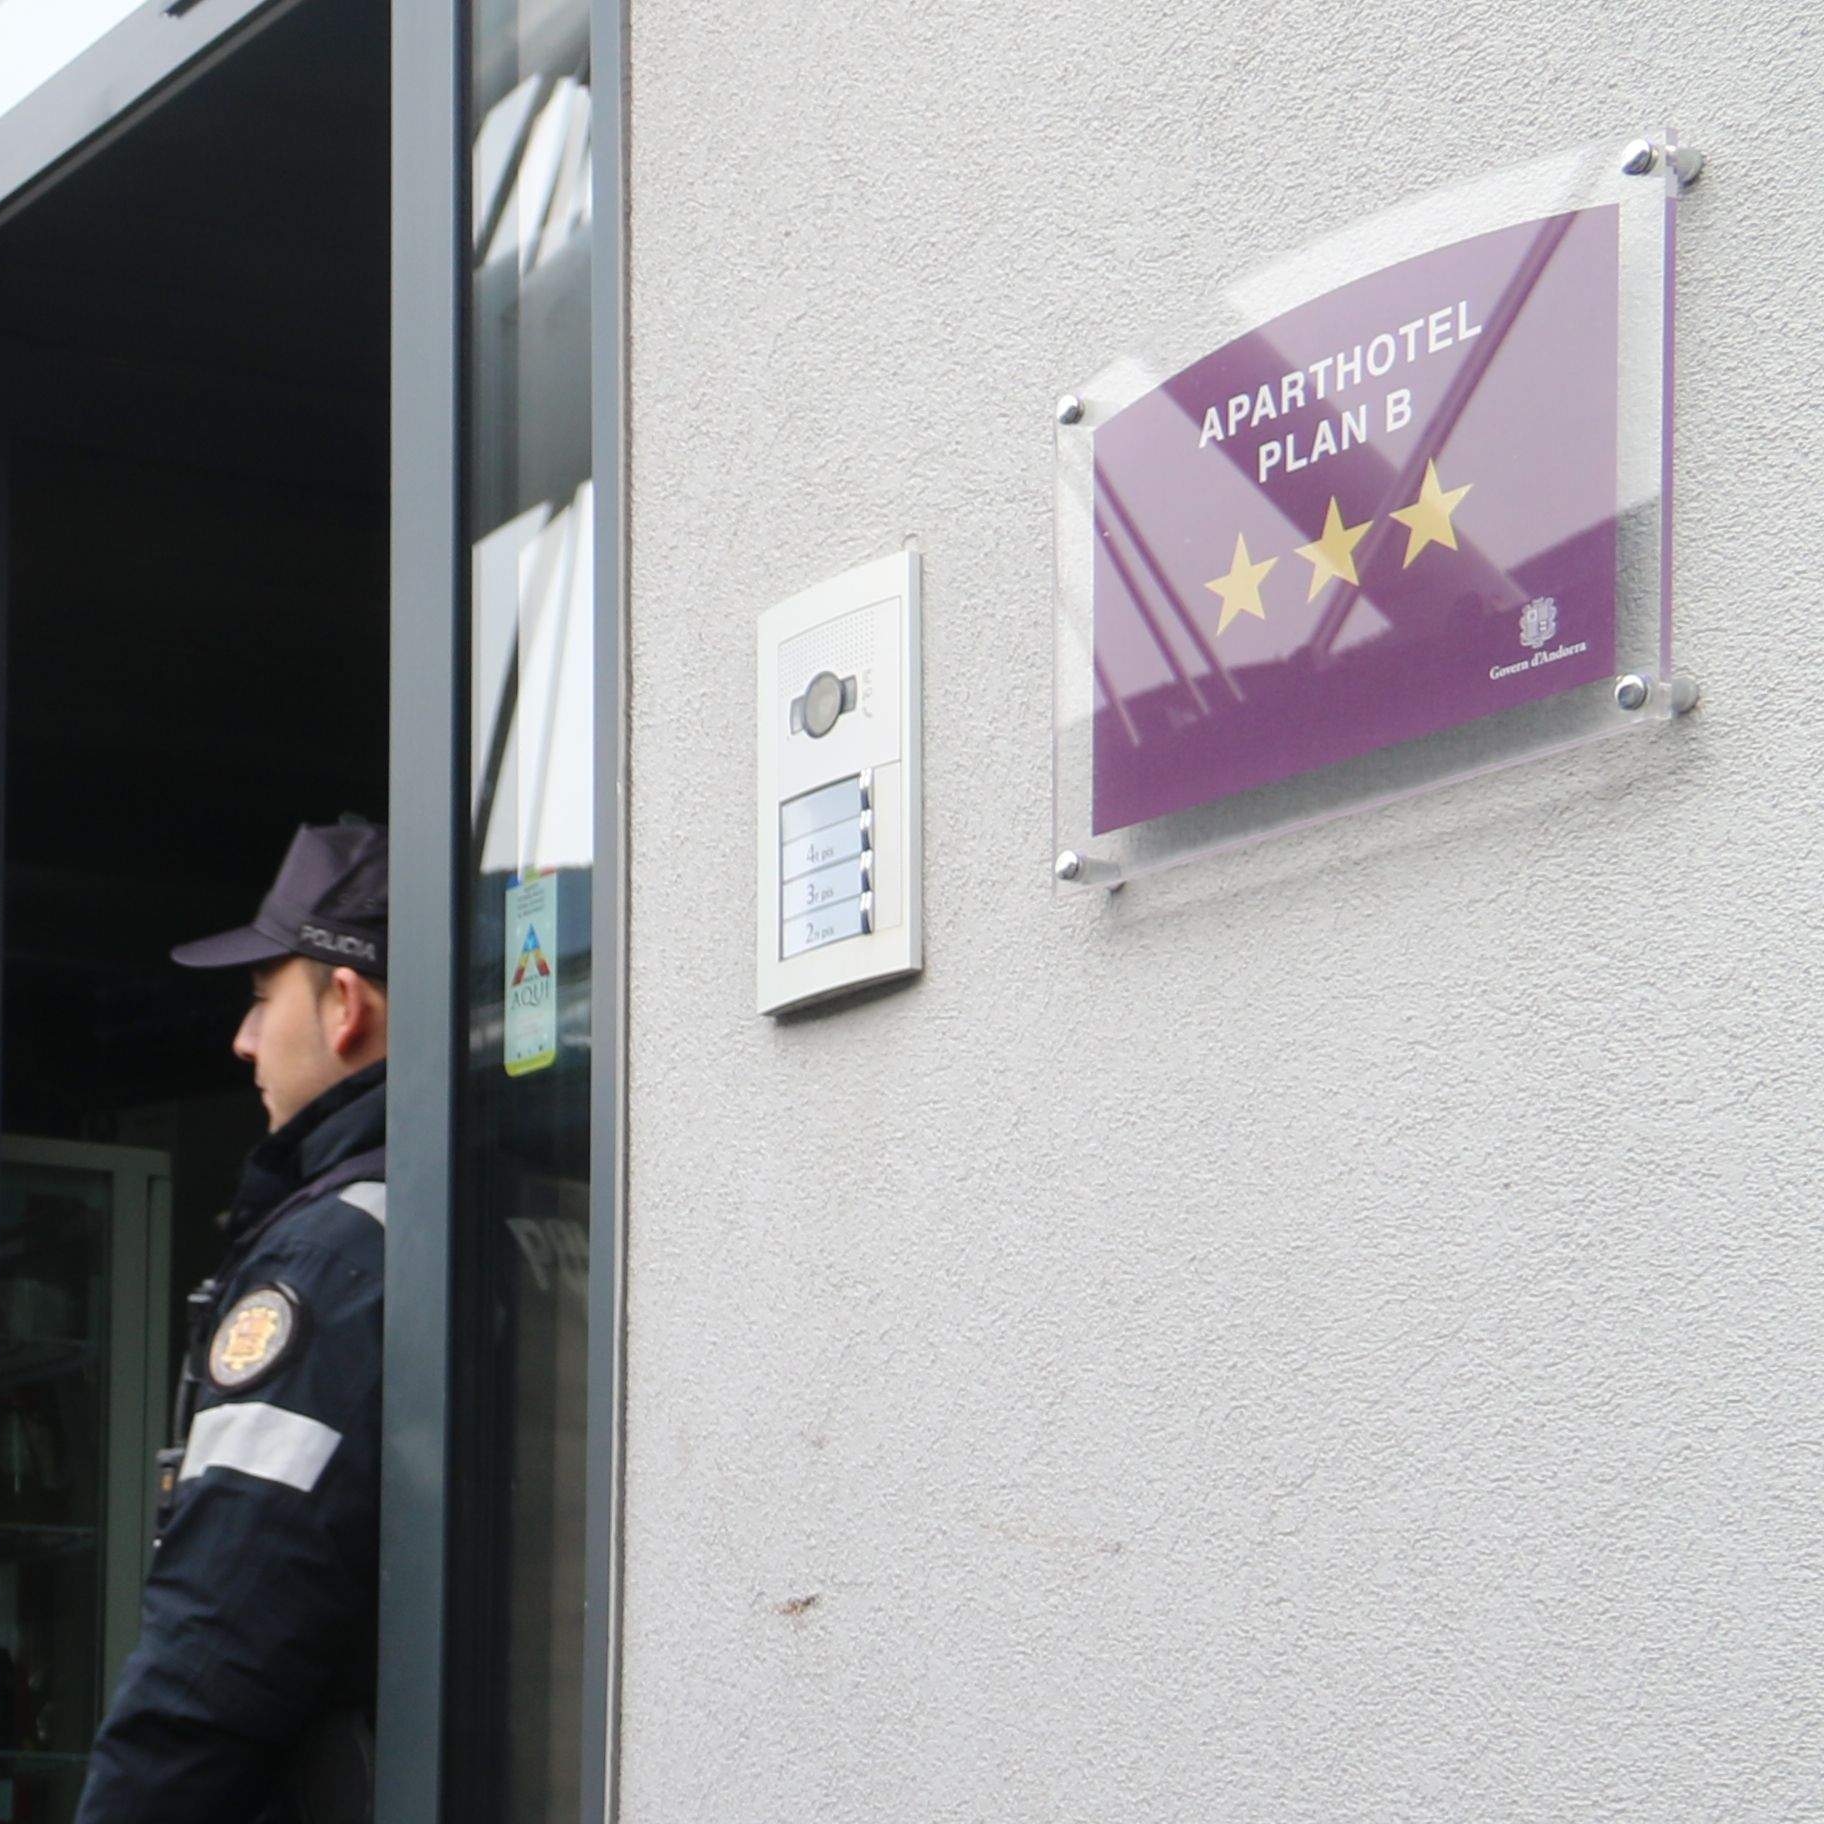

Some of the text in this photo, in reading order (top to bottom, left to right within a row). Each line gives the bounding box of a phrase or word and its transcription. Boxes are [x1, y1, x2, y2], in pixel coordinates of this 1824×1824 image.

[1198, 300, 1483, 449] APARTHOTEL
[1258, 388, 1412, 483] PLAN B
[1489, 641, 1587, 680] Govern d'Andorra
[301, 924, 377, 962] POLICIA
